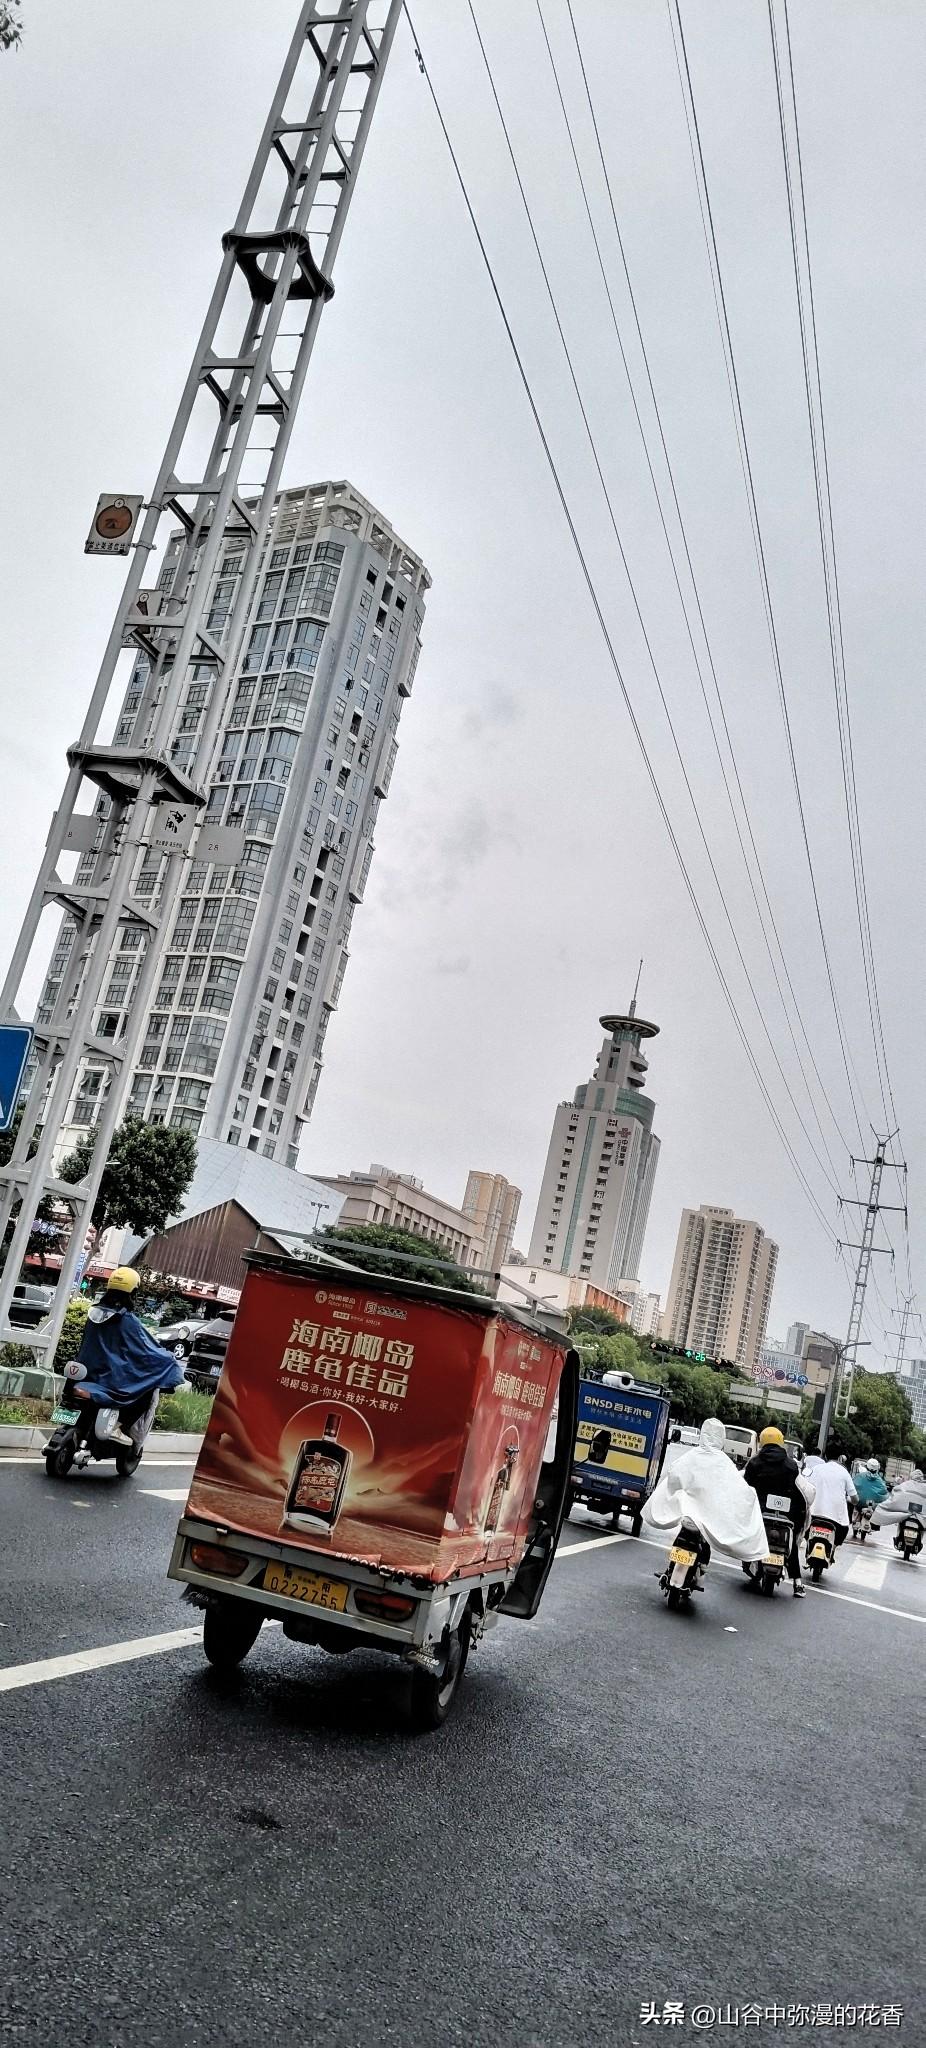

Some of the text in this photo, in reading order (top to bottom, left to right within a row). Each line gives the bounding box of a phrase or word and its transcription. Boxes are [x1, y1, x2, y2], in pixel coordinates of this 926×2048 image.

[208, 843, 220, 851] 28
[287, 1318, 415, 1370] 海南椰岛
[695, 1351, 706, 1362] 26
[279, 1347, 409, 1398] 鹿龟佳品
[584, 1395, 613, 1409] BNSD
[614, 1402, 652, 1419] 百年水电
[270, 1576, 338, 1611] 0222755
